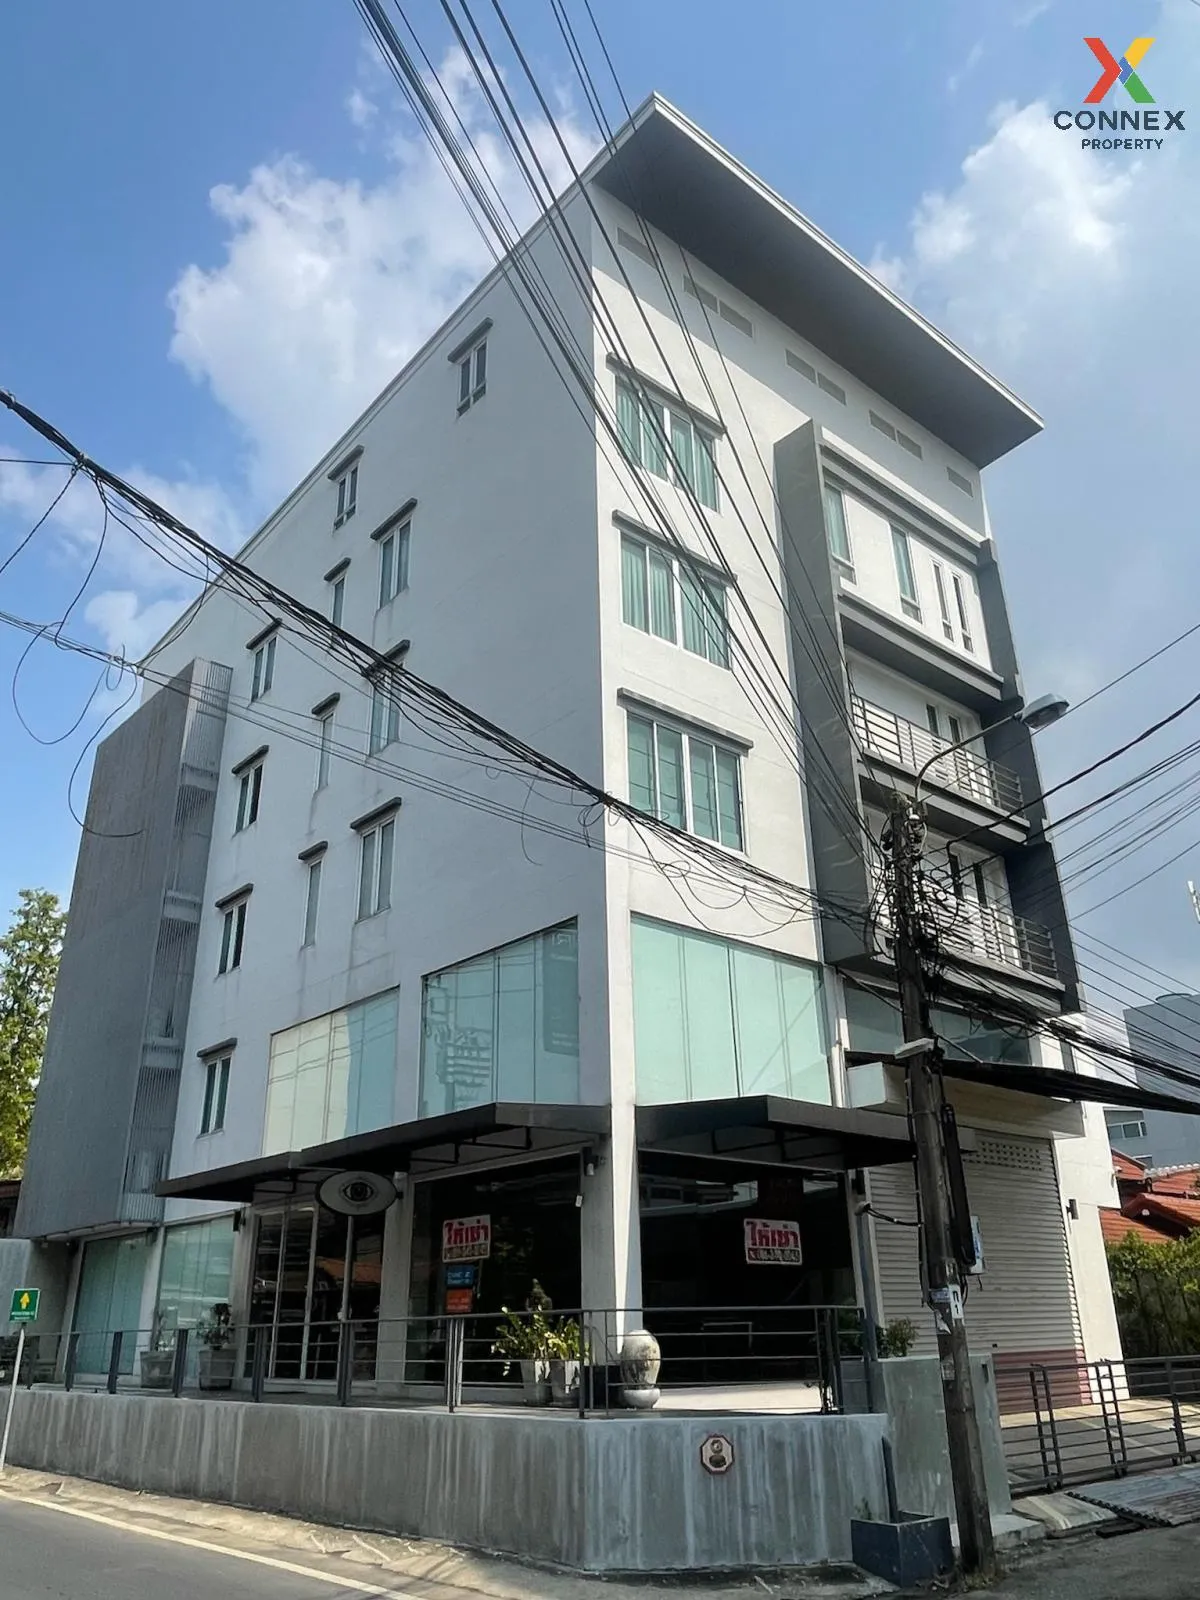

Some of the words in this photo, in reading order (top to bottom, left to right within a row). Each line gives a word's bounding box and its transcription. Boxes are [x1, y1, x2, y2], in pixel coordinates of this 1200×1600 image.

[445, 1218, 489, 1245] ให้เช่า
[746, 1220, 800, 1248] ให้เช่า
